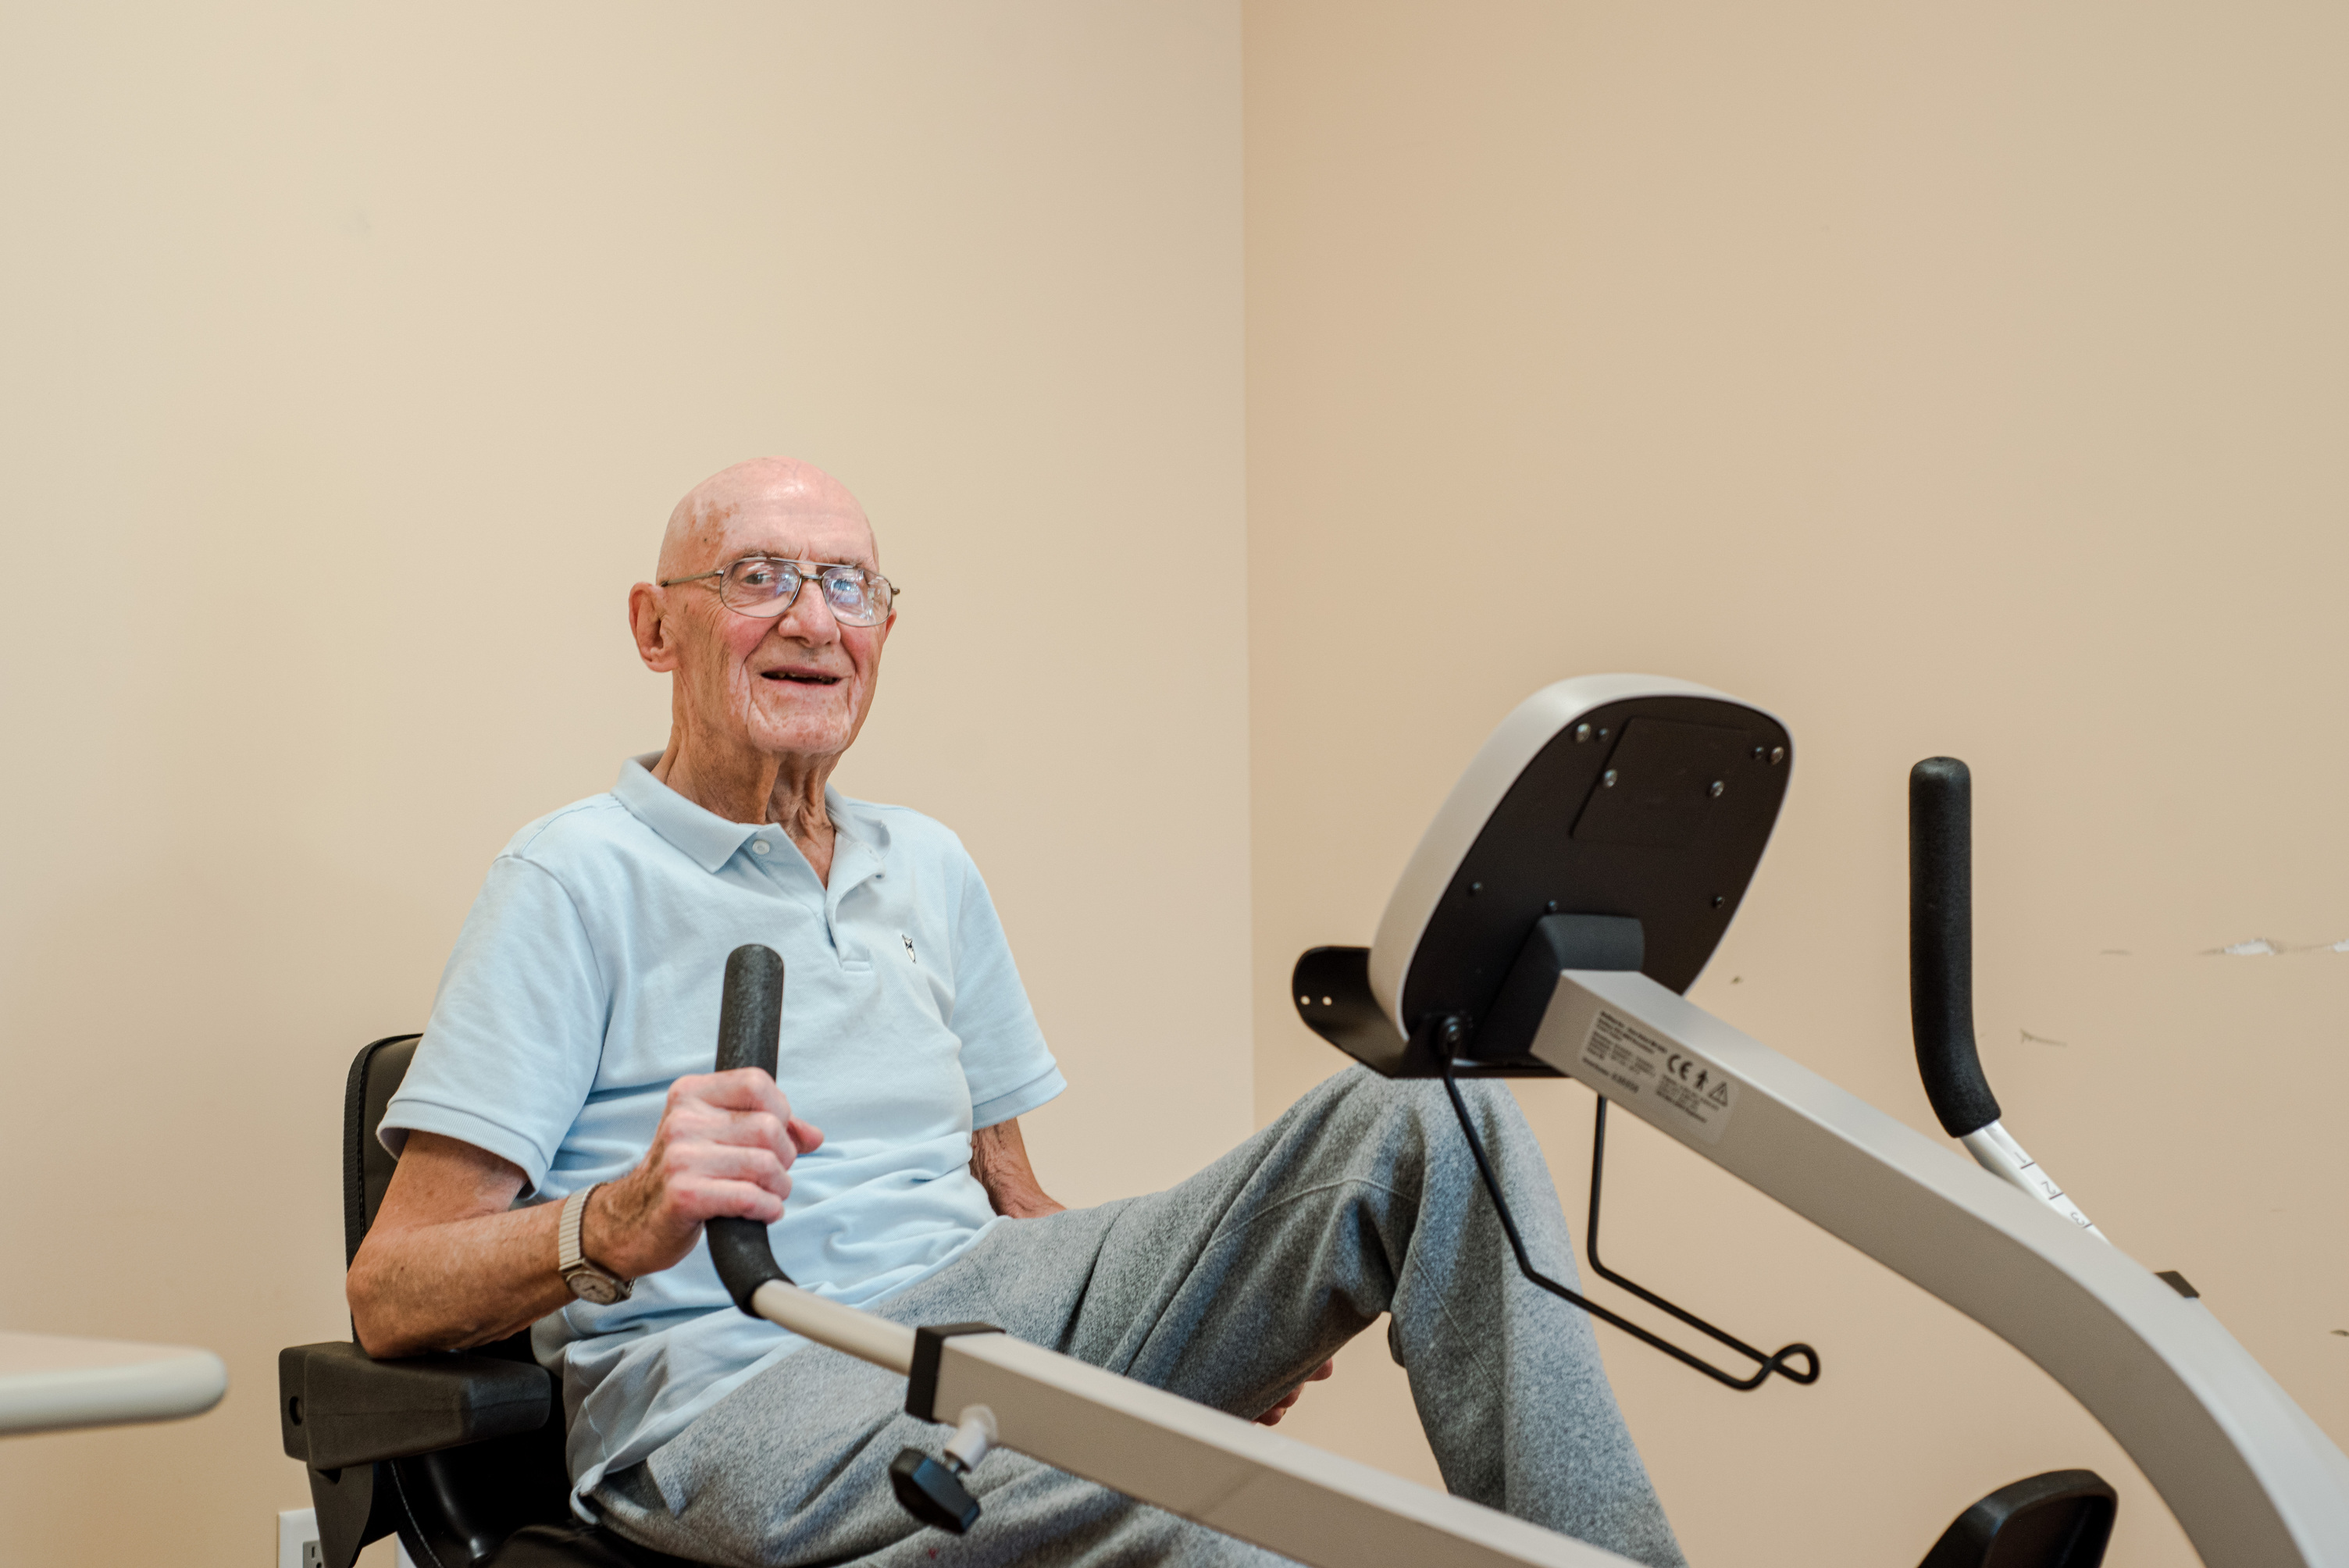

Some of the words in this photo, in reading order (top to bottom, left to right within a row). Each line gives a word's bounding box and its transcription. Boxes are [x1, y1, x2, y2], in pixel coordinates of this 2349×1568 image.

[1666, 1054, 1693, 1082] CE
[2014, 1152, 2026, 1164] 1
[2041, 1181, 2056, 1195] 2
[2070, 1212, 2085, 1226] 3
